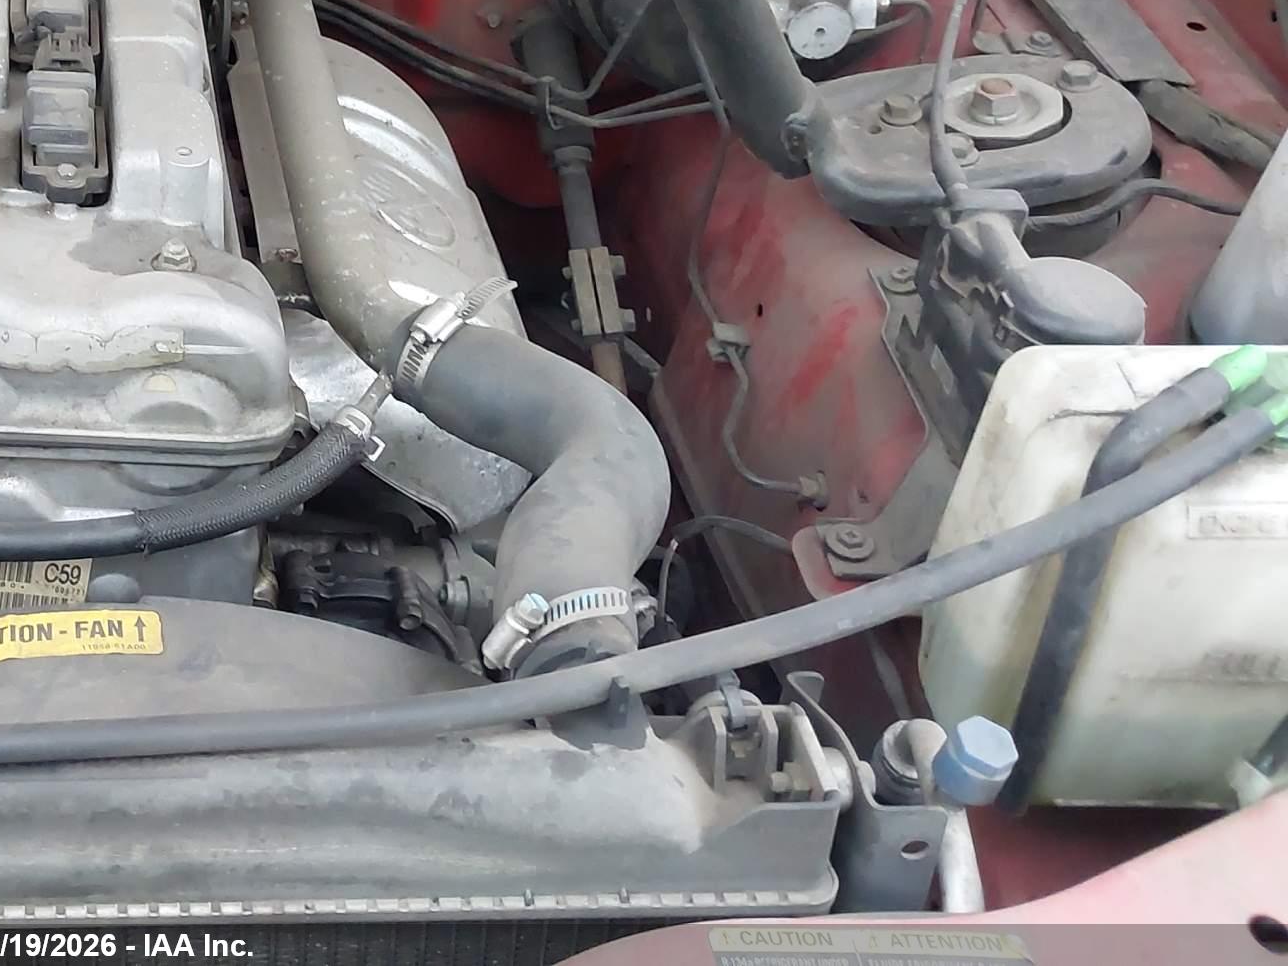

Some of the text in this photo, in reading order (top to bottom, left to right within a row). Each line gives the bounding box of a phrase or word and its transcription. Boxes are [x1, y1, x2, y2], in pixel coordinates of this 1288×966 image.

[44, 563, 82, 585] C59
[75, 619, 124, 639] FAN
[739, 930, 834, 947] CAUTION
[890, 933, 1003, 952] ATTENTION
